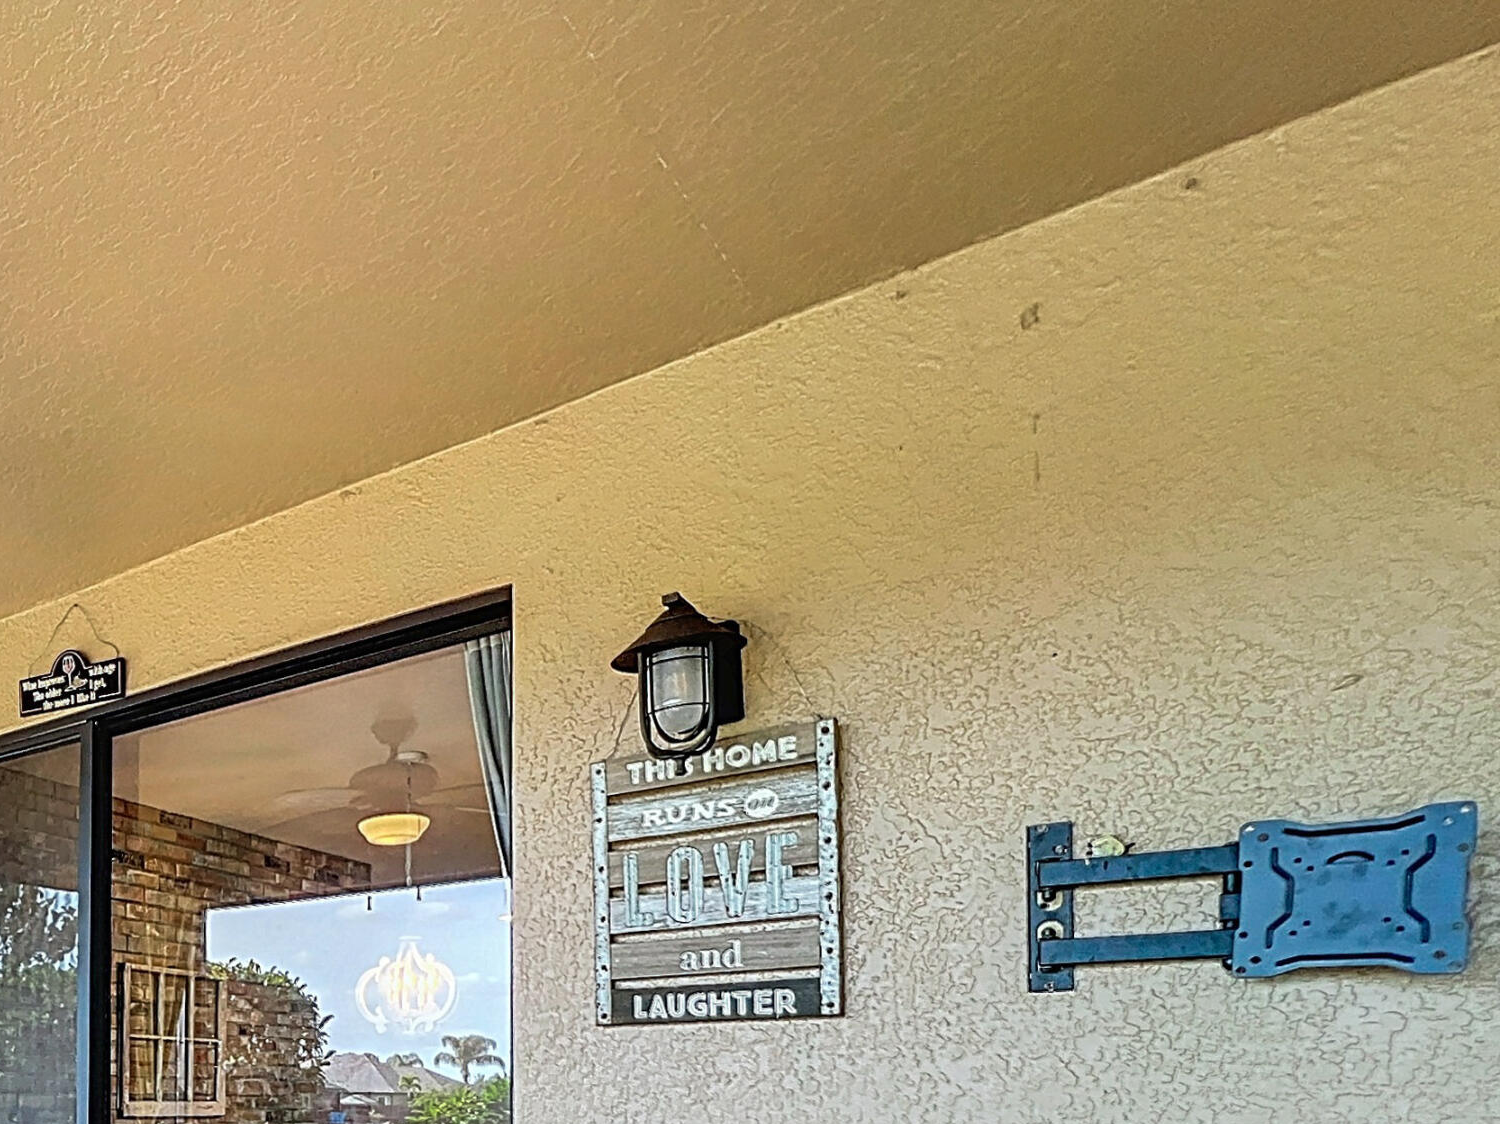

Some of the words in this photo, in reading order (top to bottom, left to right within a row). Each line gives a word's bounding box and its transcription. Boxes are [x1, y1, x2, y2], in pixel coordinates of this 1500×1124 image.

[701, 735, 798, 773] HOME
[641, 798, 737, 828] RUNS
[622, 831, 800, 928] LOVE
[679, 939, 743, 972] and
[633, 989, 797, 1020] LAUGHTER
